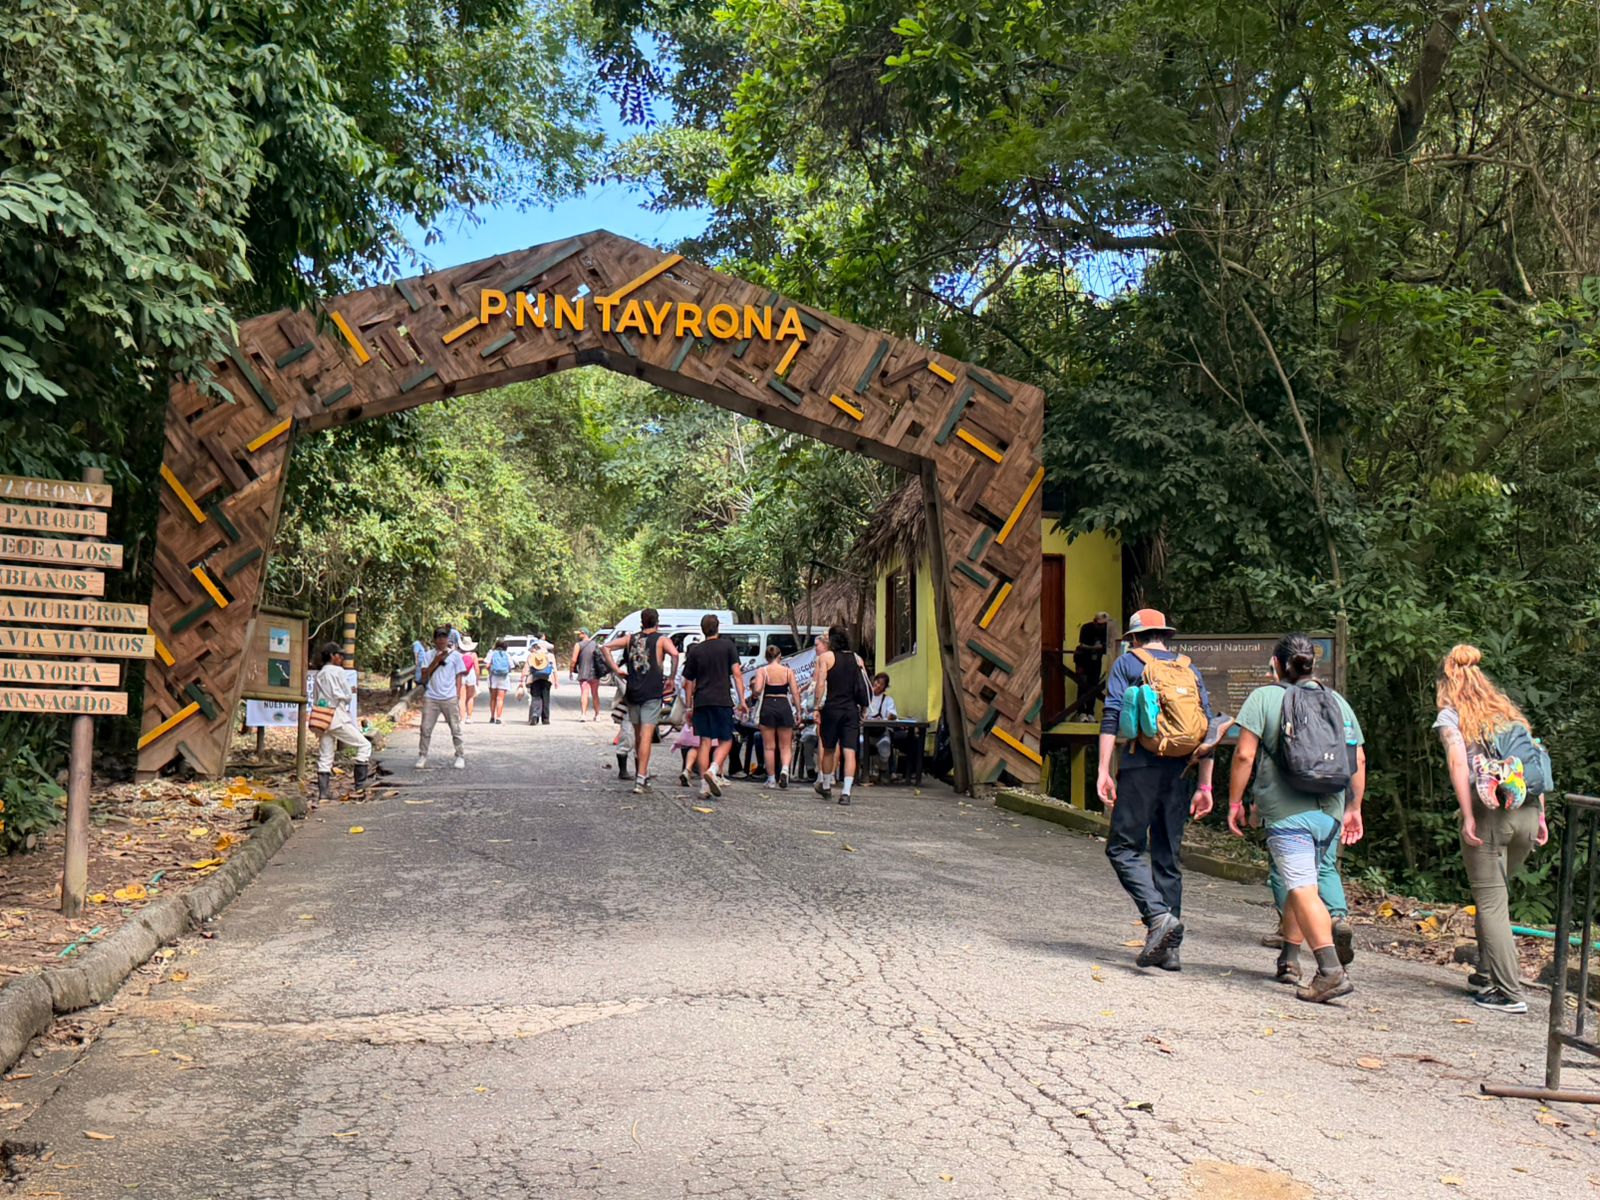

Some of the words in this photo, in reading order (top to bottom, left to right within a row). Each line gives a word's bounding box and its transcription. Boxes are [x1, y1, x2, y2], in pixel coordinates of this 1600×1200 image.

[480, 288, 585, 332] PNN
[594, 295, 807, 343] TAYRONA
[0, 478, 94, 503] AYRONA
[5, 506, 96, 531] PARQUE
[50, 542, 64, 559] A
[72, 543, 113, 562] LOS
[0, 567, 88, 591] BIANOS
[24, 600, 136, 623] MURIERON
[0, 629, 45, 648] VIA
[54, 631, 144, 653] VIVIMOS
[1180, 643, 1222, 652] Nacional
[1224, 643, 1261, 652] Natural
[34, 693, 112, 713] NACIDO
[263, 701, 298, 709] NUESTRO
